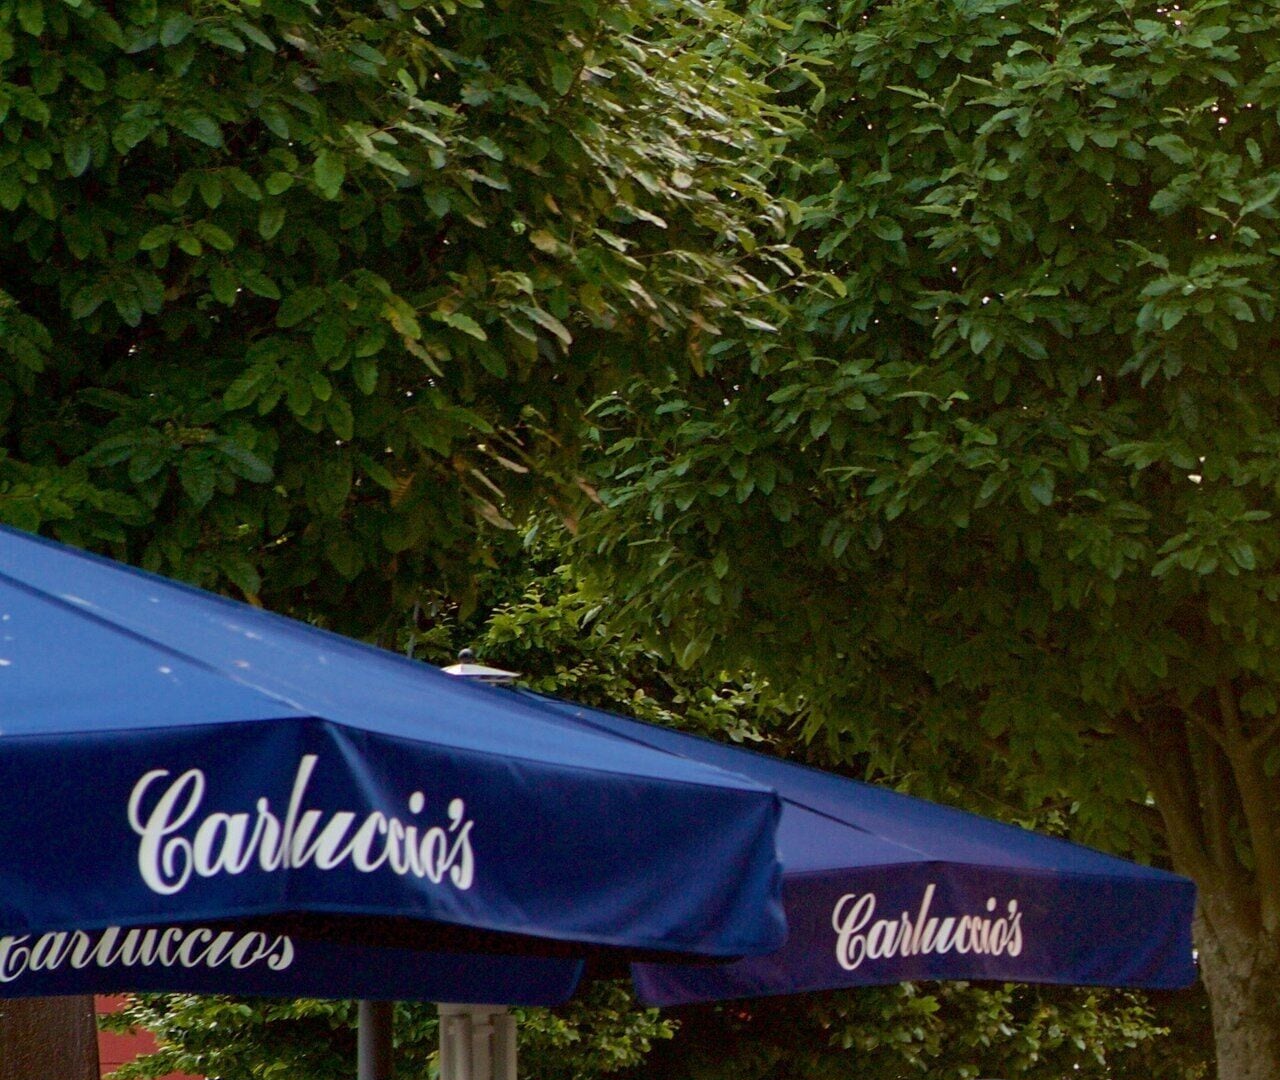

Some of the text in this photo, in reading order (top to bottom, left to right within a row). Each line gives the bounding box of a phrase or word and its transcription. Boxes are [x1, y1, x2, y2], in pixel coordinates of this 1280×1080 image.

[127, 753, 476, 896] Carluccio's
[0, 926, 294, 983] arluccios
[831, 883, 1024, 972] Carluccio's
